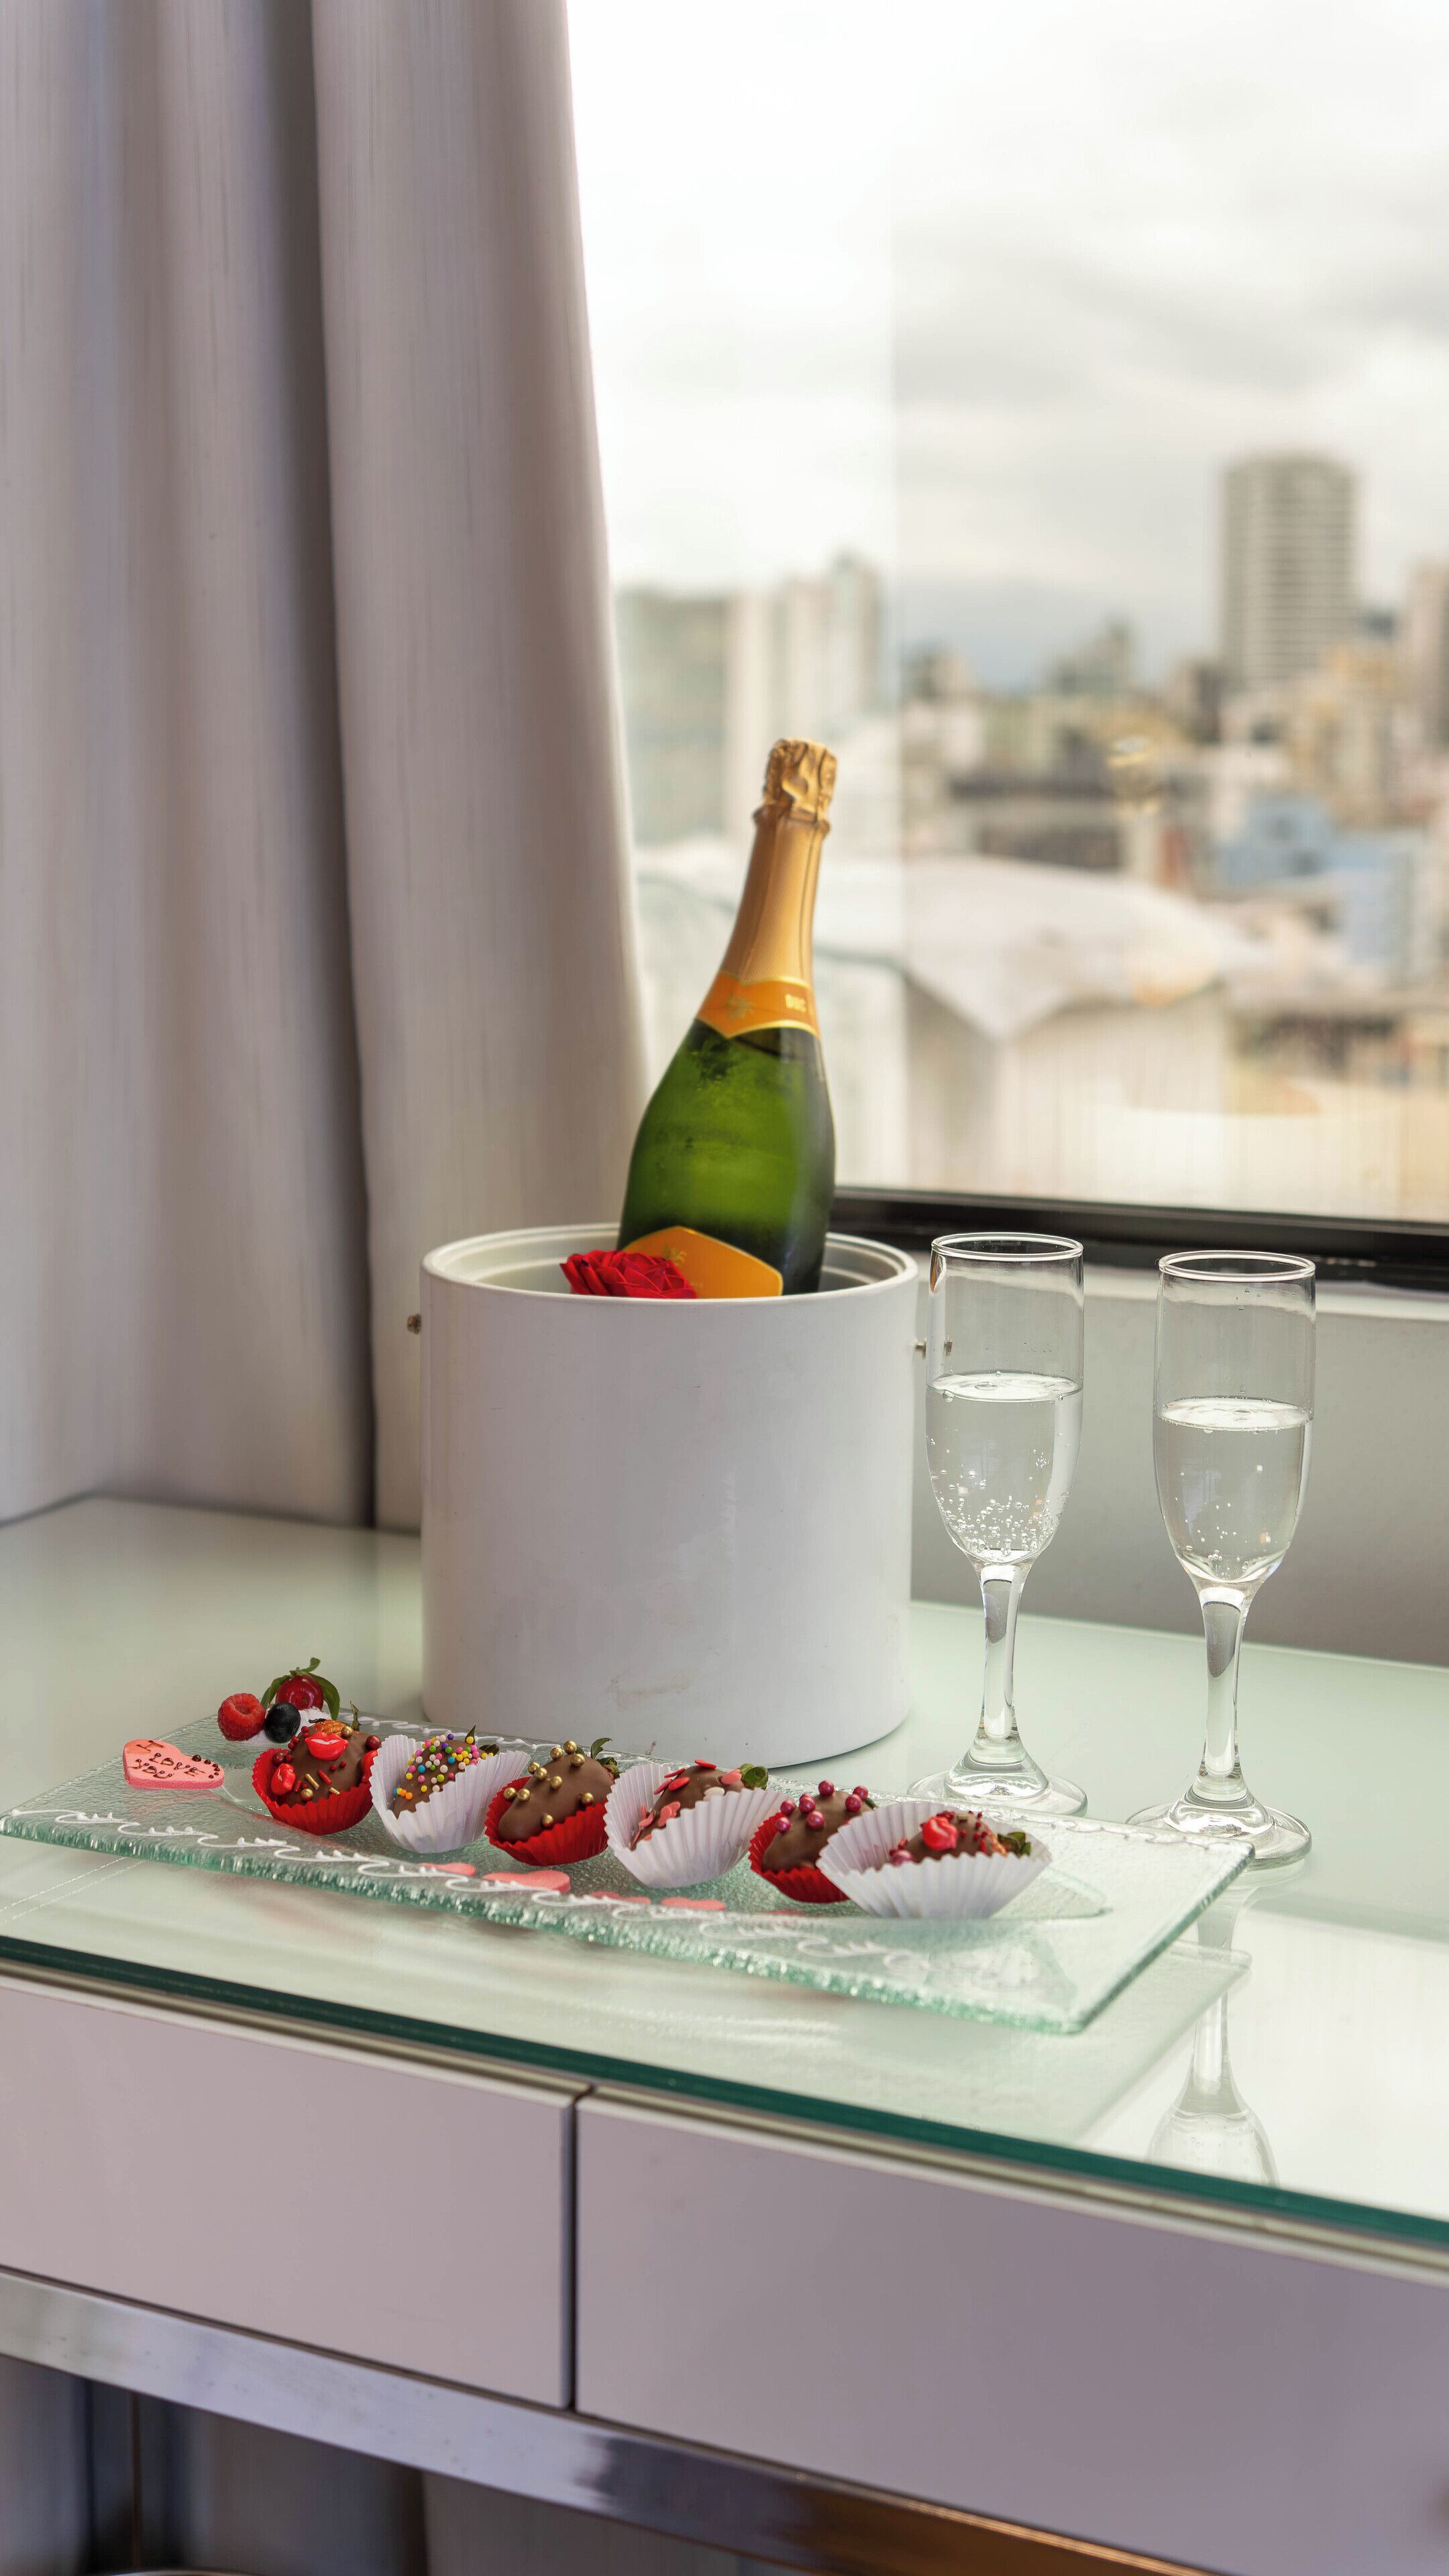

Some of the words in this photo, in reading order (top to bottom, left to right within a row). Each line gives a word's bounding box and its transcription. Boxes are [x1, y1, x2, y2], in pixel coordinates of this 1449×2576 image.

[136, 1739, 166, 1752] I
[127, 1759, 174, 1779] YOU
[149, 1752, 205, 1777] LOVE
